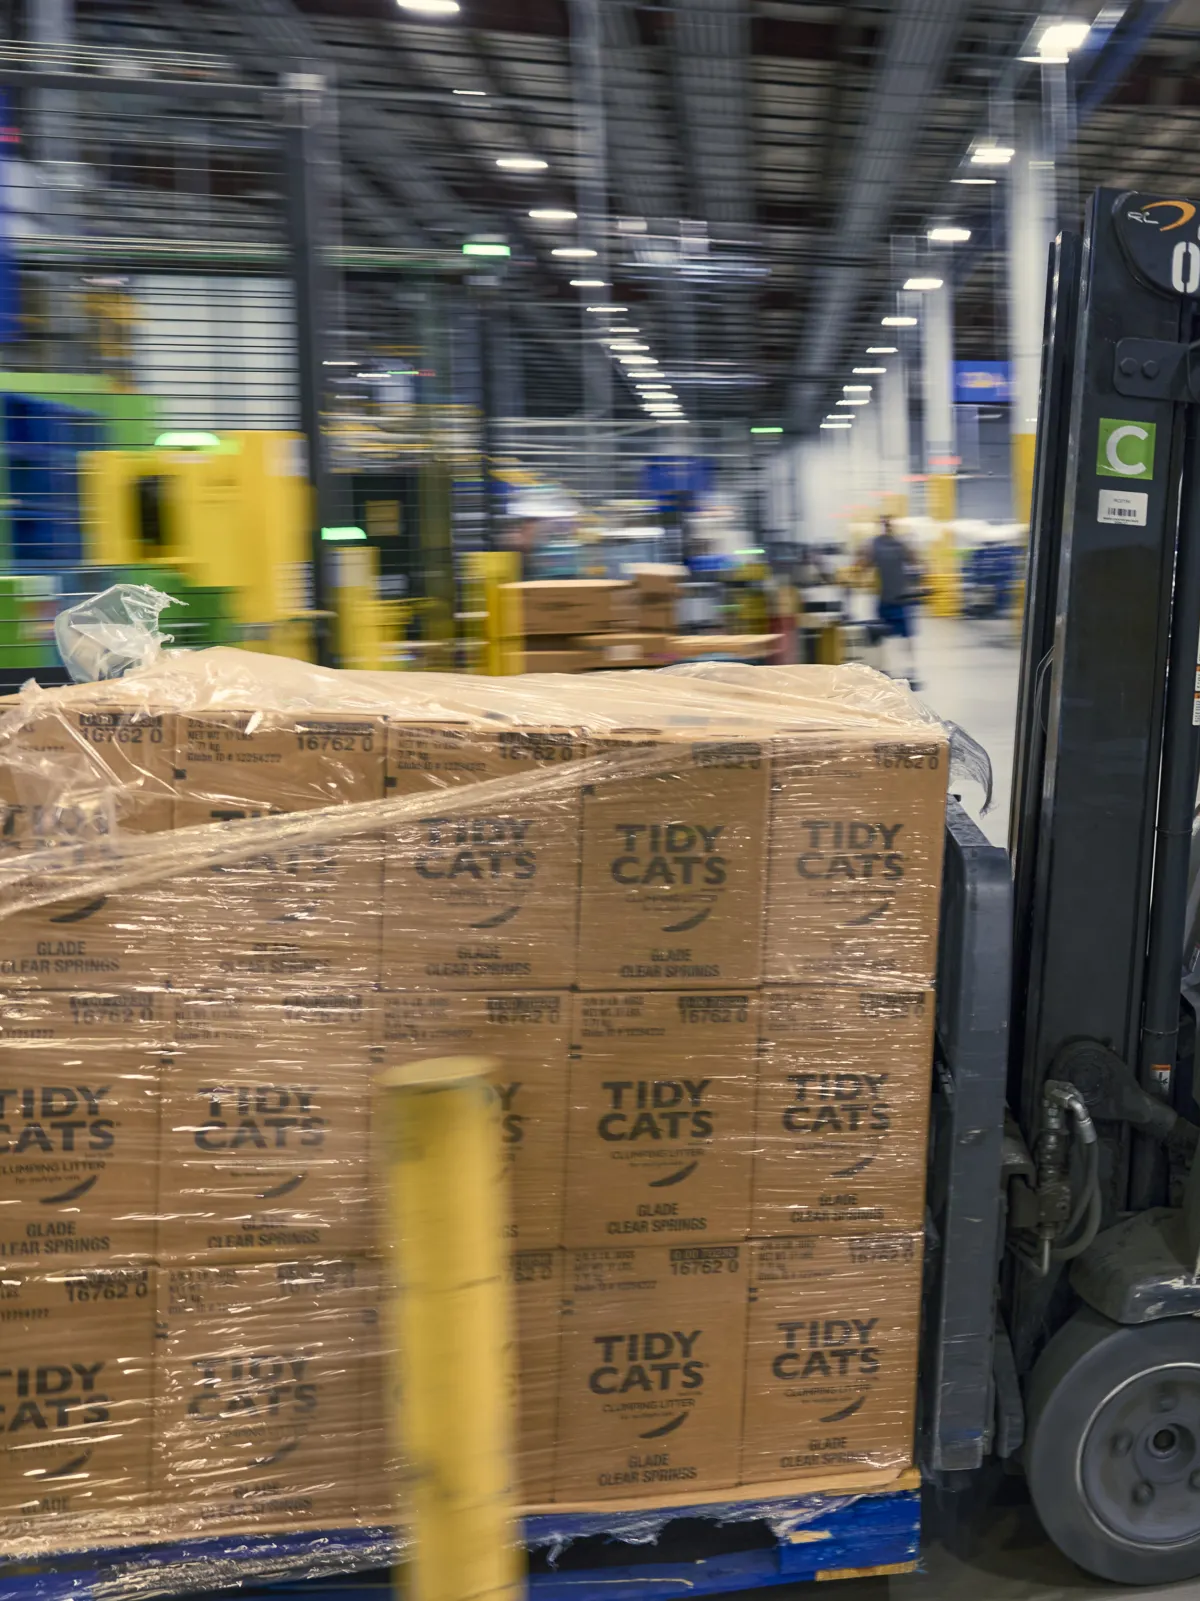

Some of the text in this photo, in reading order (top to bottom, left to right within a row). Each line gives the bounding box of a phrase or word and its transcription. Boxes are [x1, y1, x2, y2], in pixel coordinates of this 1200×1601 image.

[1106, 425, 1148, 475] C
[80, 728, 163, 743] 16762 0
[297, 736, 374, 752] 16762 0
[616, 824, 725, 853] TIDY
[801, 819, 904, 850] TIDY
[414, 851, 537, 880] CATS
[611, 855, 727, 885] CATS
[797, 852, 905, 881] CATS
[37, 941, 87, 956] GLADE
[1, 958, 121, 974] CLEAR SPRINGS
[620, 964, 721, 978] CLEAR SPRINGS
[680, 1009, 748, 1024] 16762 0
[197, 1086, 321, 1117] TIDY
[602, 1079, 713, 1109] TIDY
[786, 1073, 889, 1102] TIDY
[0, 1086, 112, 1119] TIDY
[597, 1111, 714, 1141] CATS
[782, 1103, 891, 1133] CATS
[194, 1117, 326, 1151] CATS
[0, 1161, 60, 1175] LUMPING
[637, 1203, 679, 1217] GLADE
[26, 1221, 77, 1237] GLADE
[208, 1229, 321, 1249] CLEAR SPRINGS
[607, 1217, 708, 1235] CLEAR SPRINGS
[0, 1236, 111, 1256] LEAR SPRINGS
[668, 1259, 740, 1276] 16762 0
[65, 1283, 148, 1303] 16762 0
[593, 1330, 703, 1363] TIDY
[776, 1317, 880, 1349] TIDY
[192, 1353, 311, 1389] TIDY
[588, 1361, 704, 1395] CATS
[772, 1347, 881, 1380] CATS
[0, 1394, 110, 1432] ATS
[186, 1384, 318, 1422] CATS
[808, 1436, 848, 1451] GLADE
[628, 1453, 669, 1469] GLADE
[780, 1454, 820, 1468] CLEAR
[598, 1466, 697, 1486] CLEAR SPRINGS
